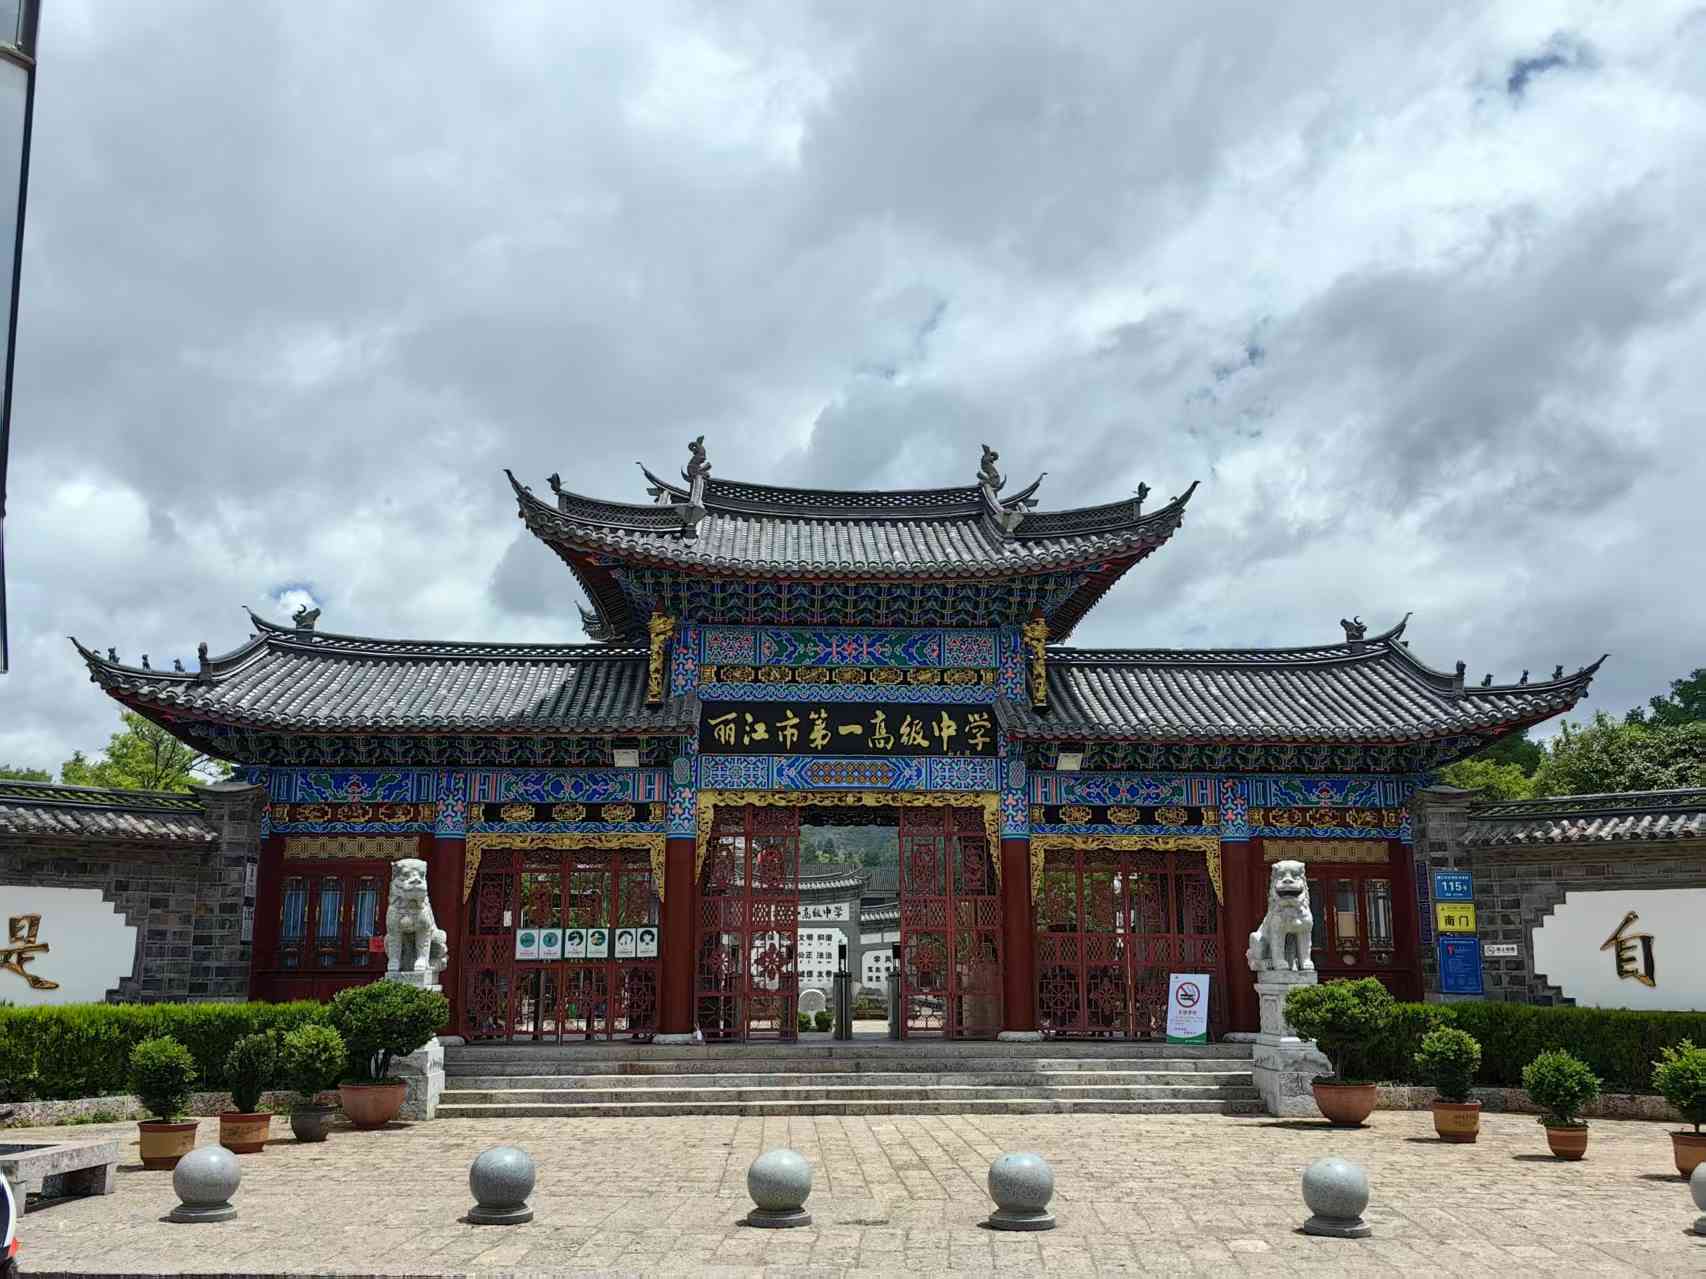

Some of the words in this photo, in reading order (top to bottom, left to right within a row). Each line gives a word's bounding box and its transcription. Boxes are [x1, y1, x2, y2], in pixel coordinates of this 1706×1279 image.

[707, 708, 992, 751] 丽江市第一高级中学
[1444, 914, 1469, 927] 南门
[1600, 911, 1656, 987] 自
[0, 912, 59, 989] 是
